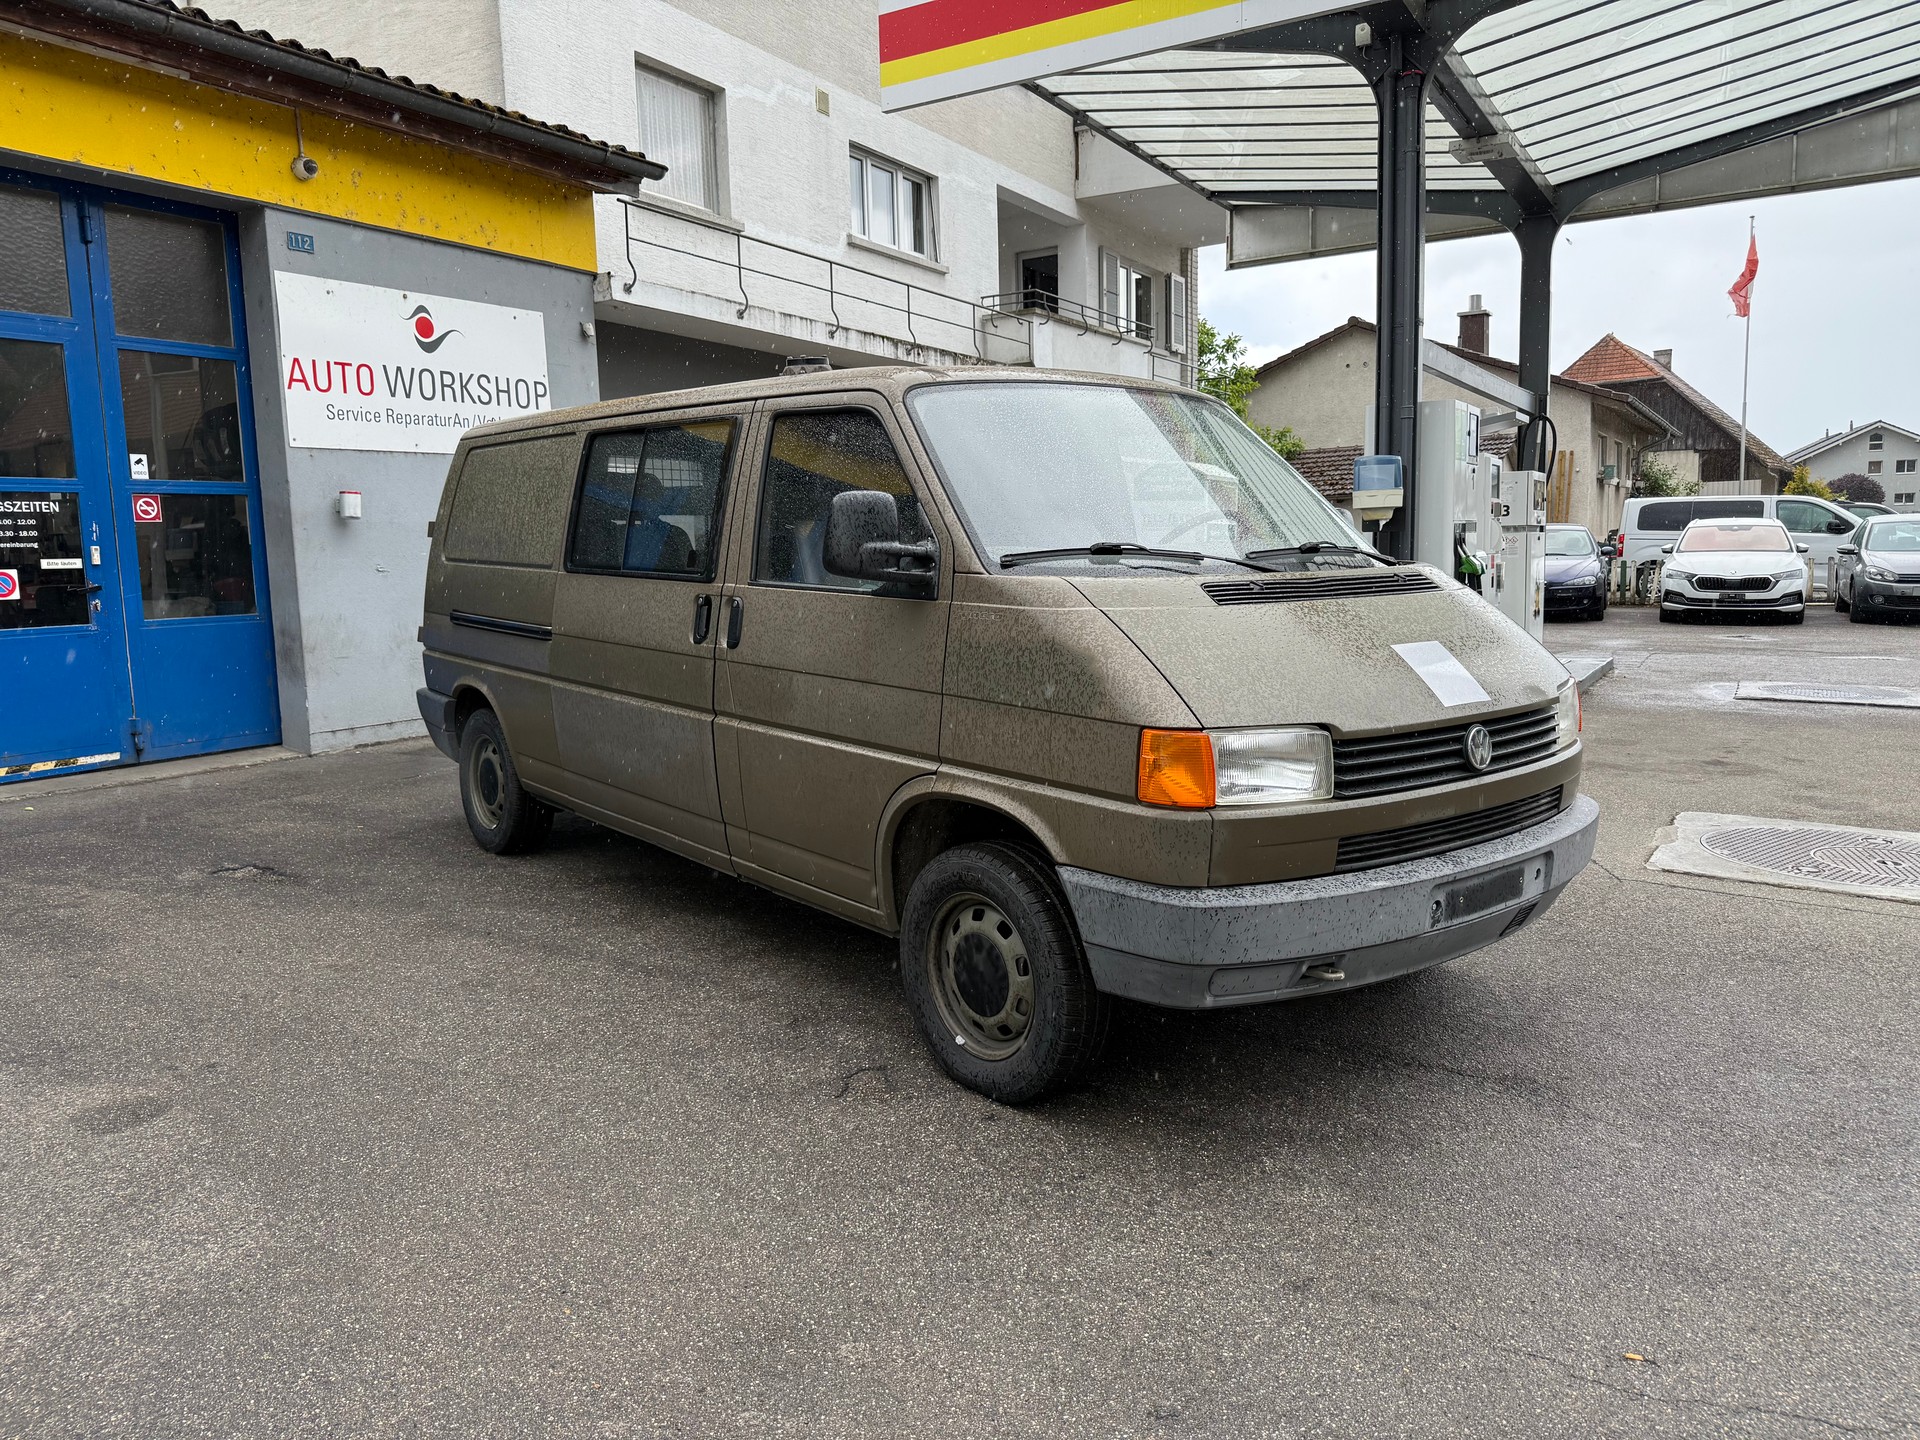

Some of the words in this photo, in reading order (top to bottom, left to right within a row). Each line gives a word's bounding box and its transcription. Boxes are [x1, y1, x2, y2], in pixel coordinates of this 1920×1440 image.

[291, 234, 311, 249] 112
[287, 357, 375, 396] AUTO
[382, 364, 548, 410] WORKSHOP
[326, 403, 381, 422] Service
[1501, 505, 1510, 517] 3
